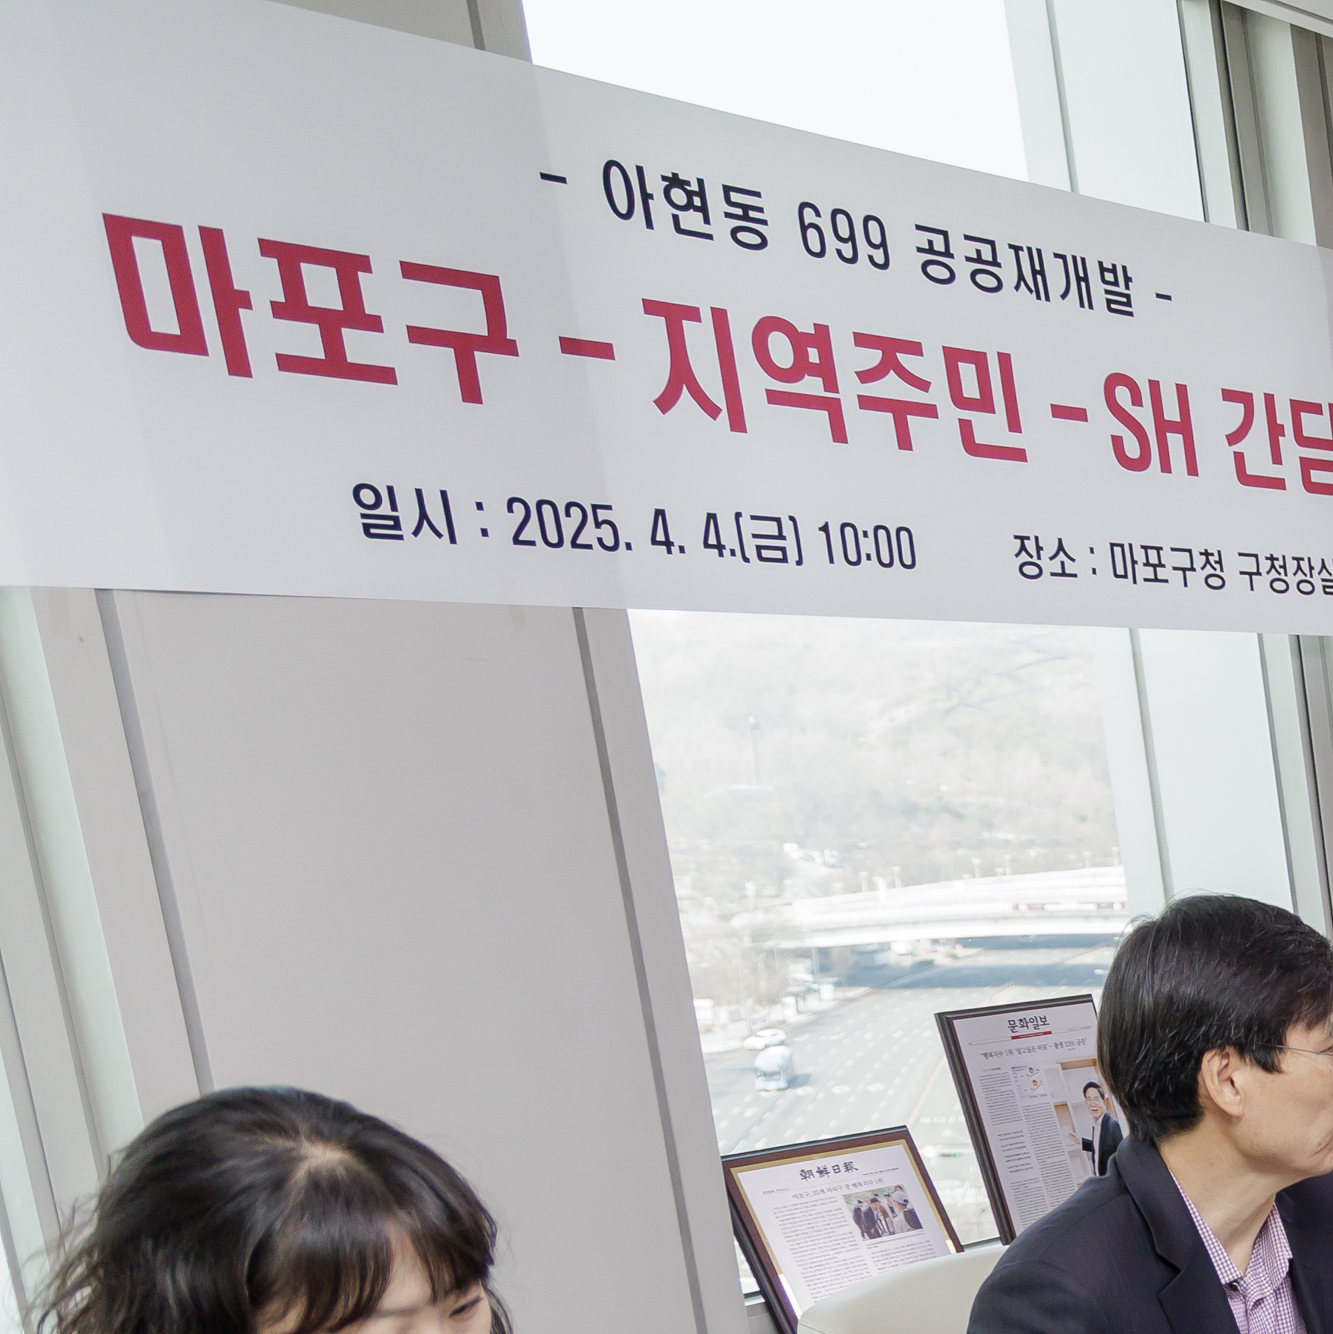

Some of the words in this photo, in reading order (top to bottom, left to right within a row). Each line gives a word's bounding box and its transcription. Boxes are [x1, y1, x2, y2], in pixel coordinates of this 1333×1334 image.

[602, 159, 769, 252] 아현동
[798, 201, 890, 271] 699
[914, 223, 1135, 318] 공공재개발
[102, 212, 520, 406] 마포구
[641, 297, 1029, 464] 지역주민
[1103, 372, 1200, 478] SH
[352, 482, 458, 545] 일시
[507, 496, 633, 553] 2025.
[650, 508, 687, 555] 4.
[818, 521, 917, 570] 10:00
[1013, 534, 1078, 580] 장소
[1109, 541, 1226, 592] 마포구청
[1008, 1015, 1050, 1034] 문화일보
[800, 1161, 859, 1181] 朝鮮日報
